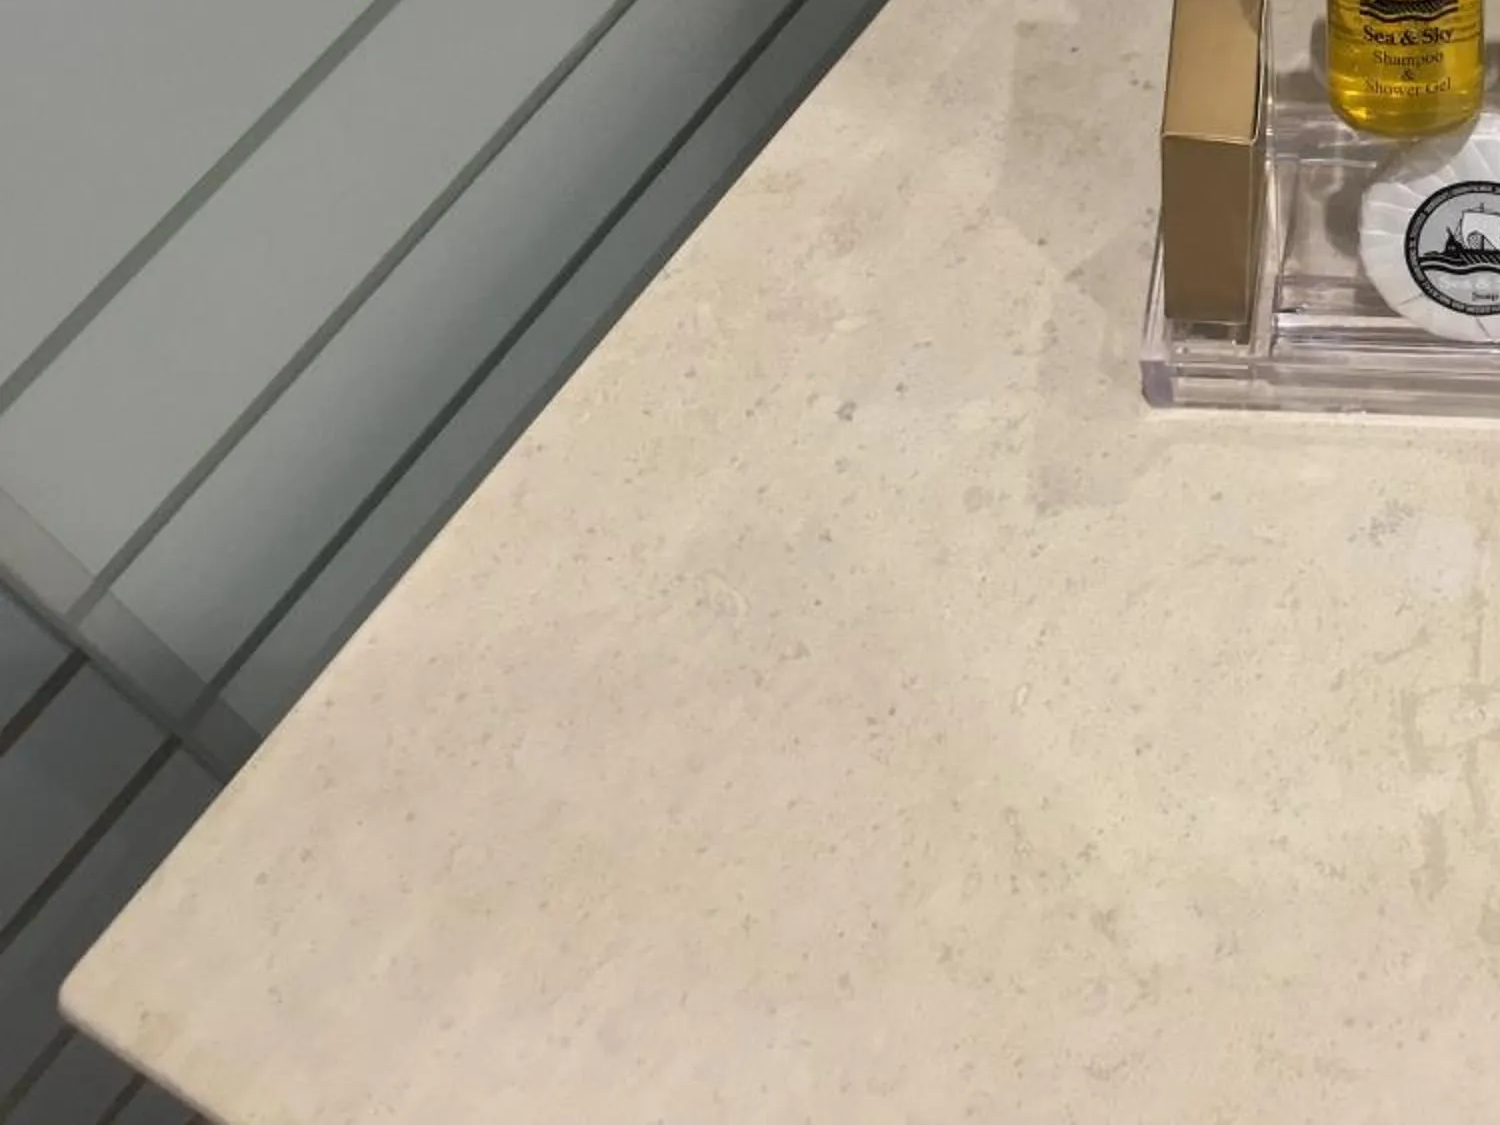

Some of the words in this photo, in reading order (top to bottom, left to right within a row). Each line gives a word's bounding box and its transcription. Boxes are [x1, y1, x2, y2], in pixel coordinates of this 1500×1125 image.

[1363, 25, 1396, 45] Sea
[1400, 28, 1418, 46] &
[1422, 26, 1454, 44] Sky
[1374, 50, 1443, 67] Shampoo
[1365, 77, 1420, 96] Shower
